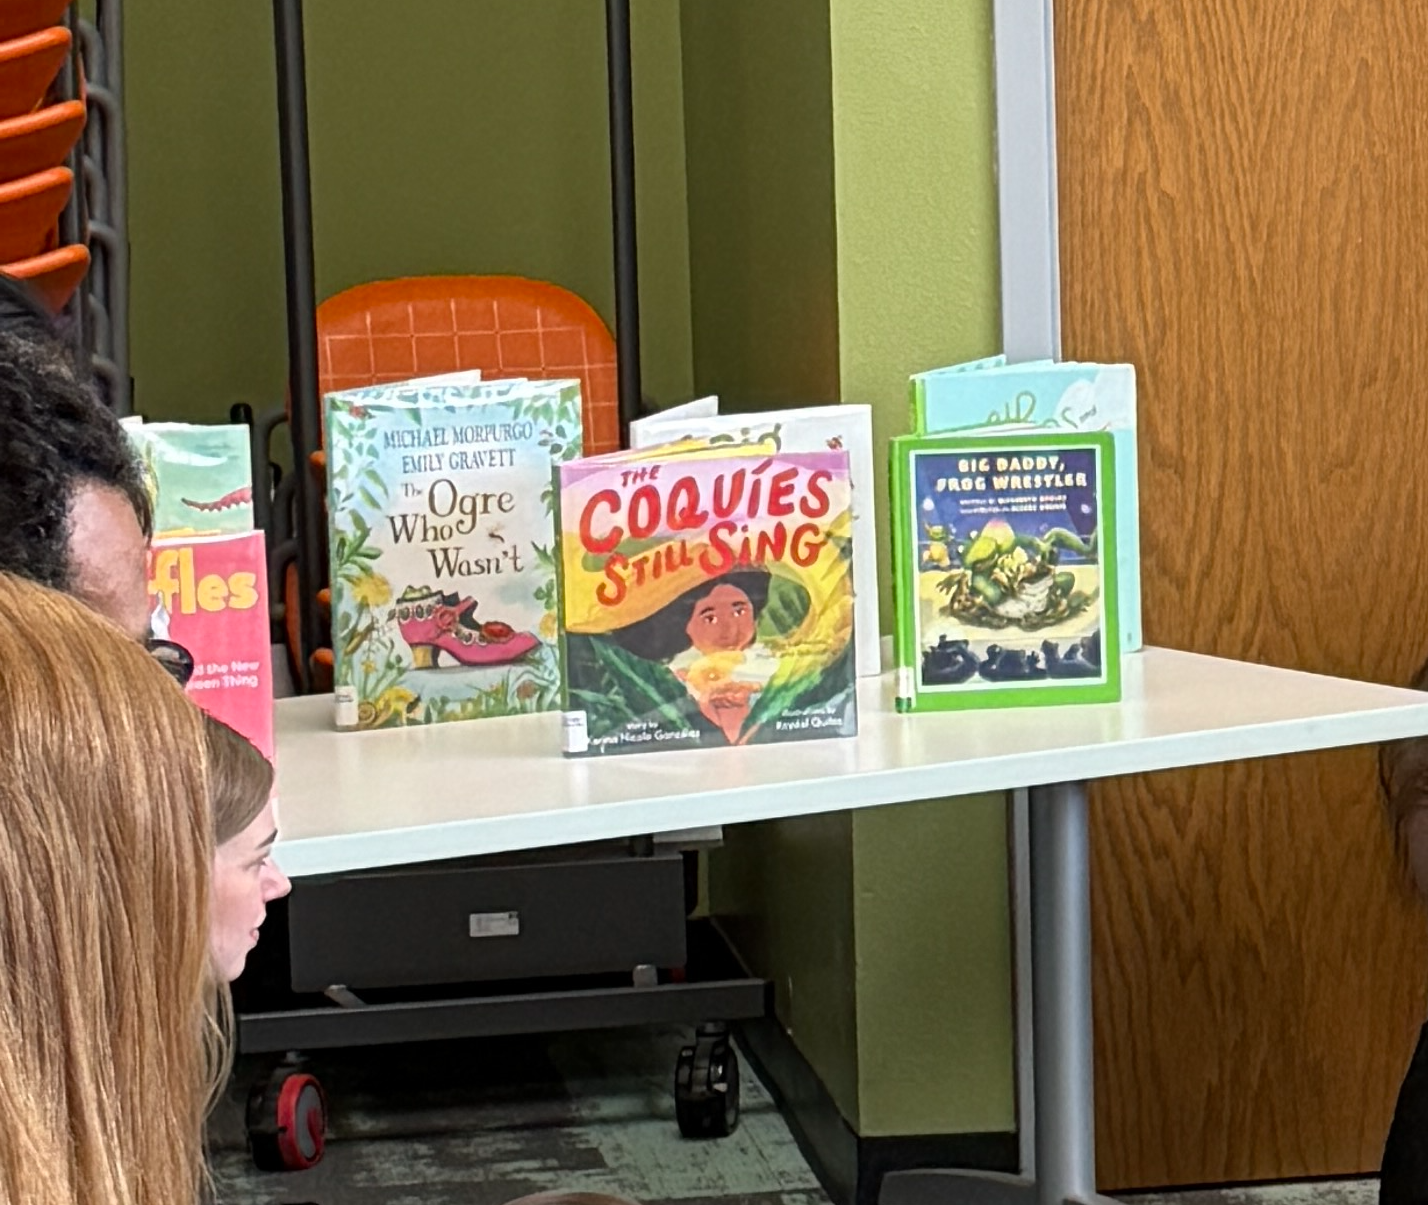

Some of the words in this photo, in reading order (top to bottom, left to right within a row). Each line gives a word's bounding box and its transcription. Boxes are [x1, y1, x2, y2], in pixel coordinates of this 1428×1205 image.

[383, 427, 449, 450] MICHAEL
[453, 421, 533, 445] MORPURGO
[402, 454, 445, 474] EMILY
[450, 449, 516, 471] GRAVETT
[620, 465, 661, 487] THE
[958, 458, 990, 473] BIG
[996, 456, 1065, 472] DADDY,
[936, 477, 986, 492] FROG
[992, 473, 1087, 491] WRESTLER
[401, 483, 423, 497] The
[428, 479, 515, 534] Ogre
[579, 459, 832, 553] COQUÍES
[386, 513, 453, 544] Who
[427, 545, 524, 579] Wasn't
[596, 540, 694, 606] STILL
[147, 547, 259, 615] fles
[231, 661, 260, 671] New
[222, 675, 258, 688] Thing
